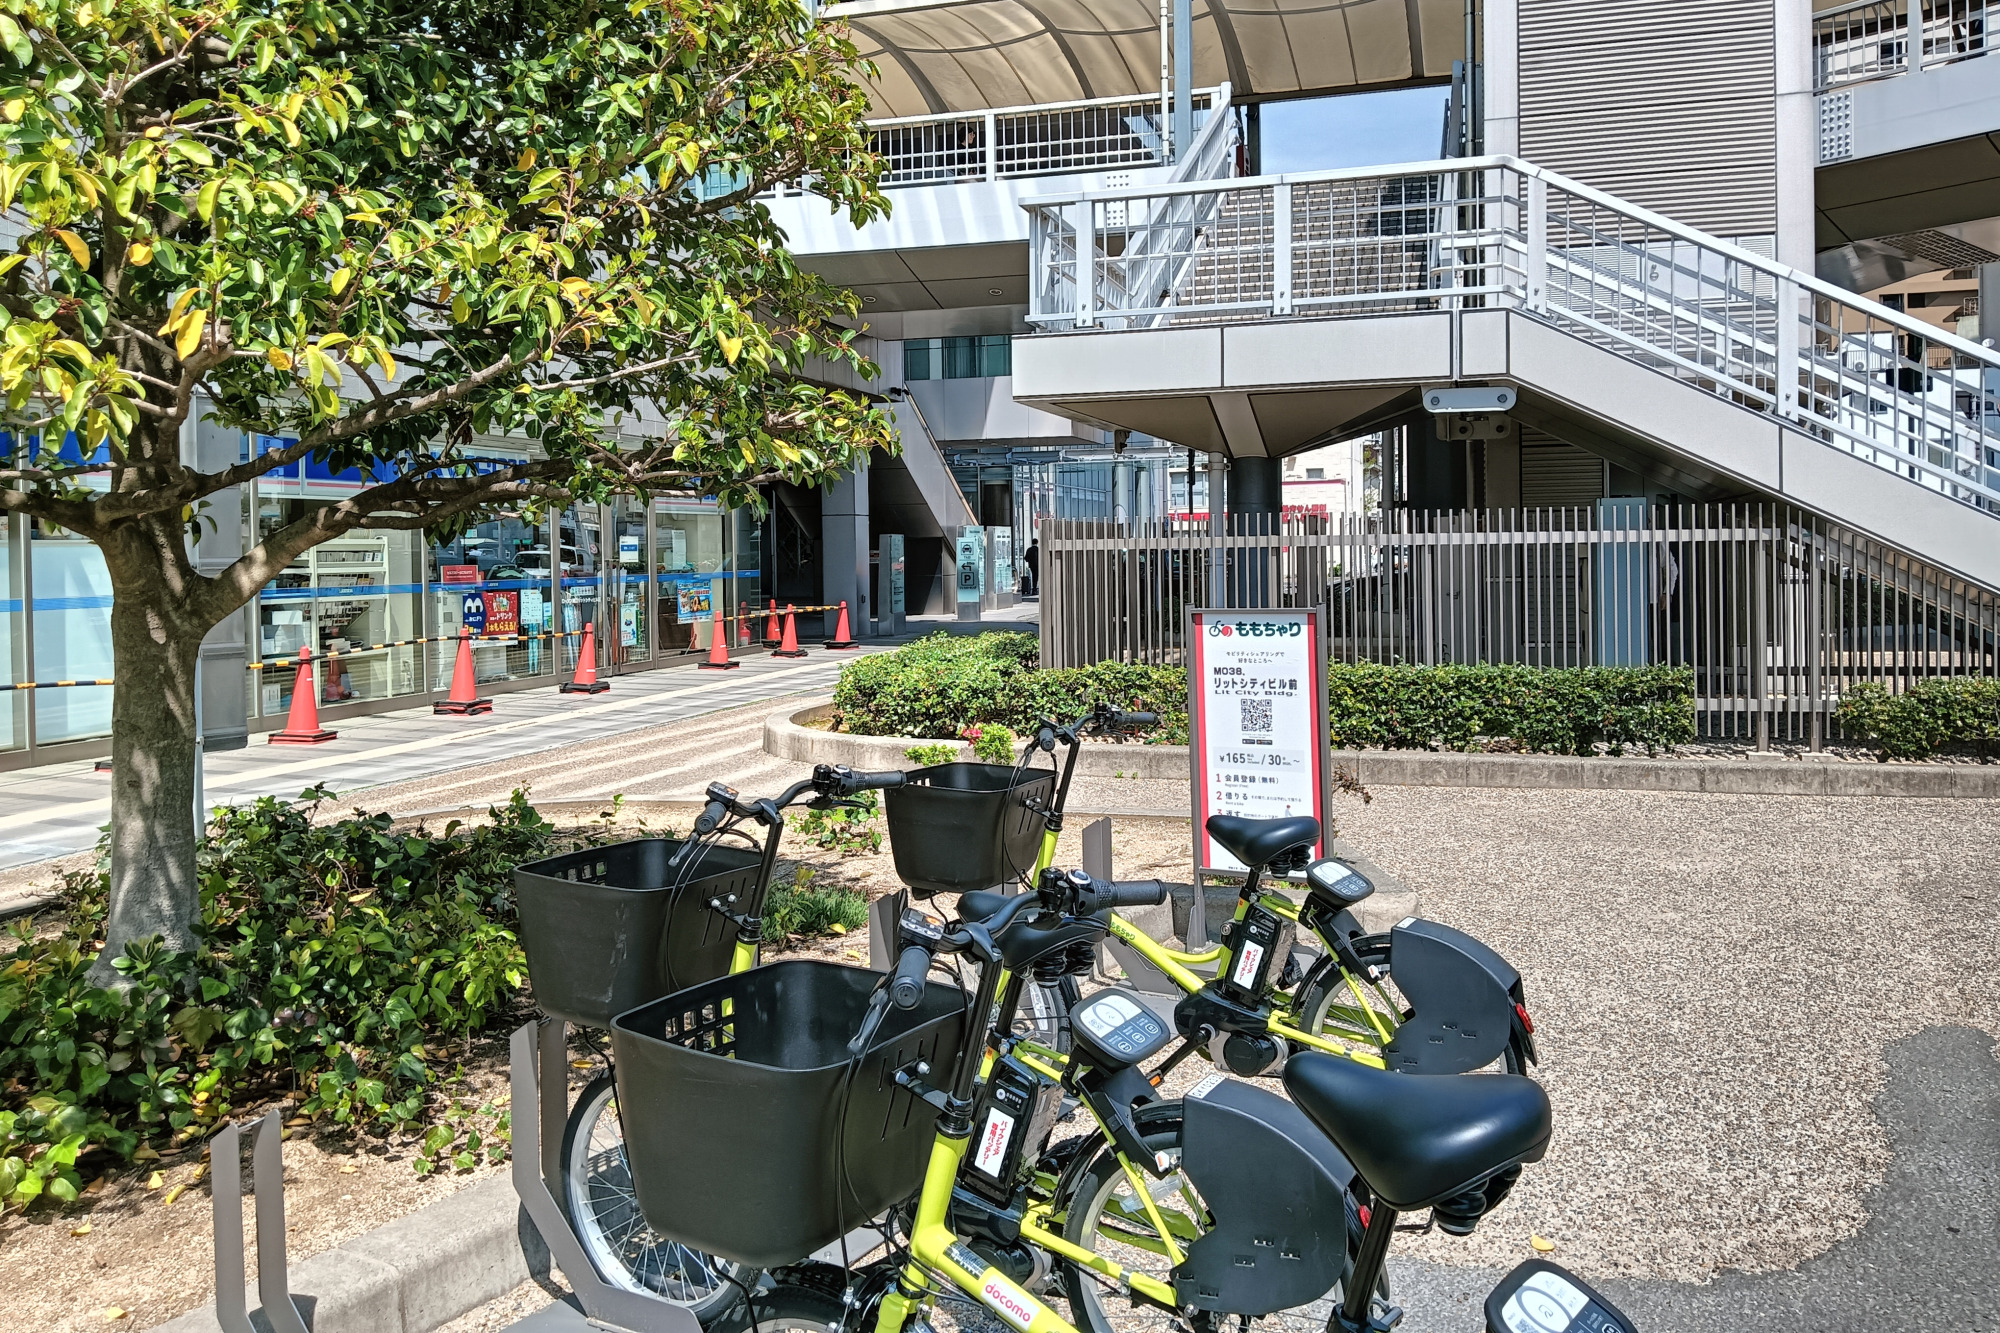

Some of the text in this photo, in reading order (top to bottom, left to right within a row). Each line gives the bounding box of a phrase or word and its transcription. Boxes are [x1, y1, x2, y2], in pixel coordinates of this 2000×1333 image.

[1235, 621, 1301, 637] ももちゃり
[1214, 667, 1245, 676] M038.
[1214, 678, 1298, 690] リットシティビル前
[1216, 774, 1220, 782] 1
[1216, 791, 1222, 800] 2
[1226, 792, 1248, 800] 借りる
[982, 1122, 998, 1166] 専用バッテリー
[992, 1120, 1008, 1156] バイクシェア
[985, 1284, 1030, 1322] docomo
